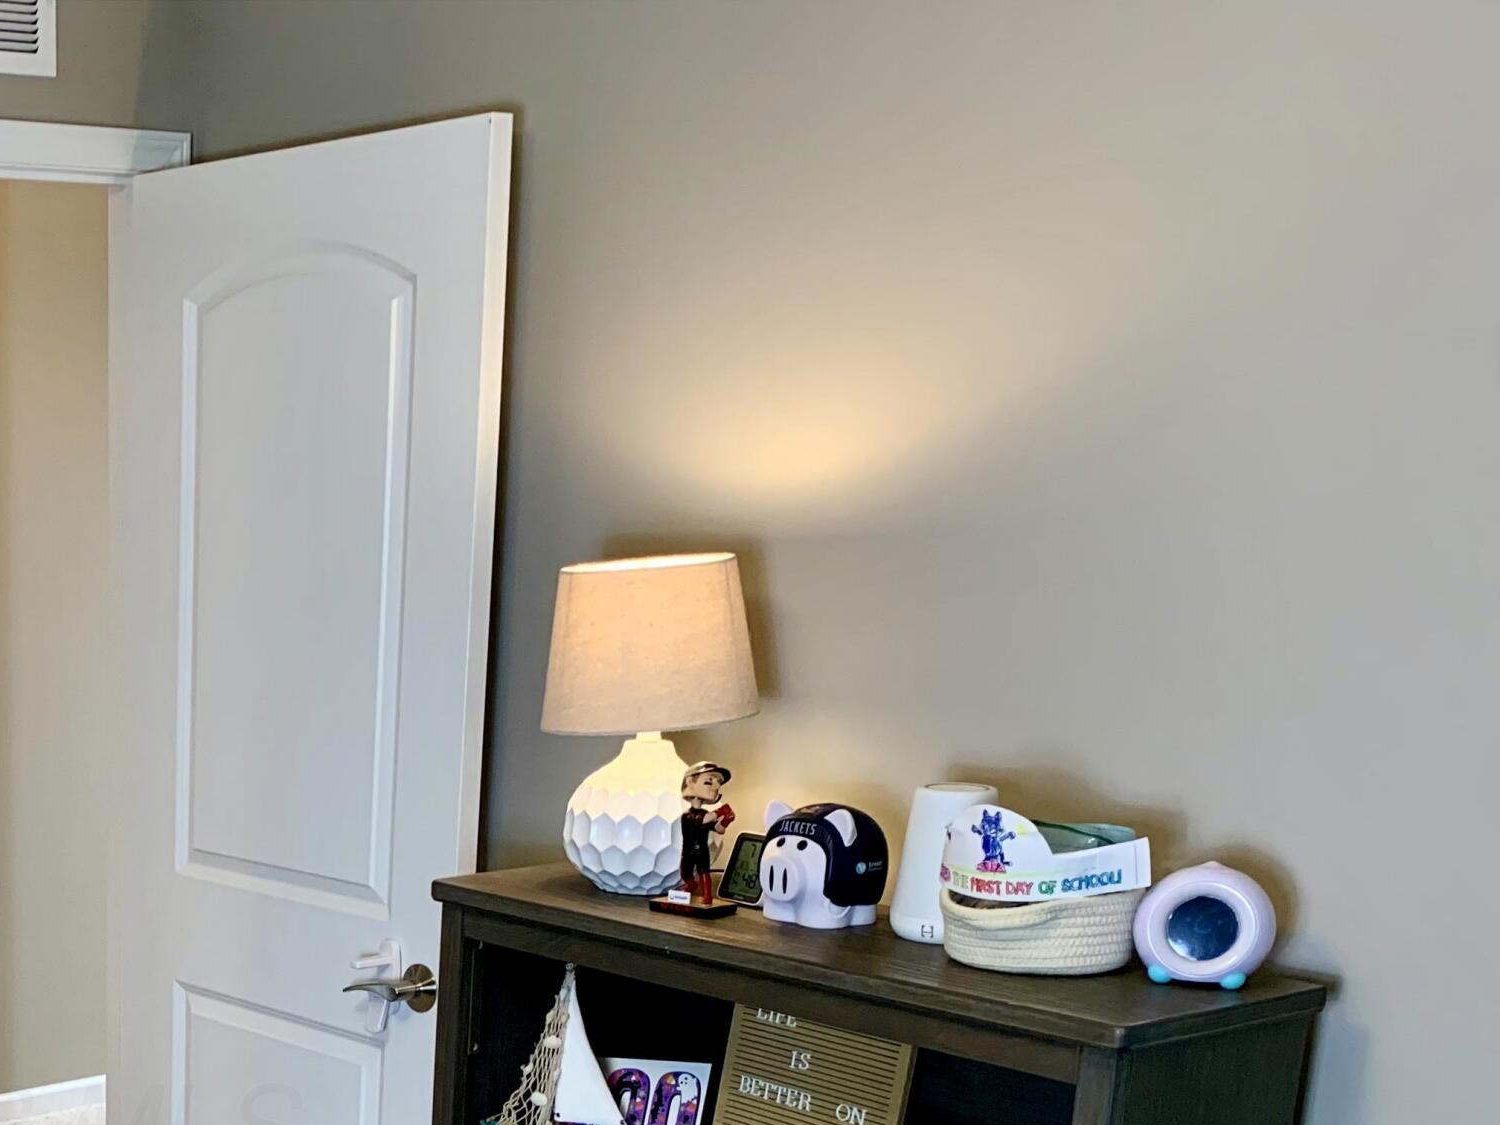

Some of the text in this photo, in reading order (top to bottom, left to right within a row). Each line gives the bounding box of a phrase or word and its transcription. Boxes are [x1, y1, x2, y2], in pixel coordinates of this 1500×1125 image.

[779, 819, 817, 836] JACKETS
[970, 876, 1002, 896] FIRST
[1005, 880, 1034, 896] DAY
[1037, 879, 1057, 895] OF
[789, 1050, 810, 1071] IS
[738, 1074, 811, 1112] BETTER
